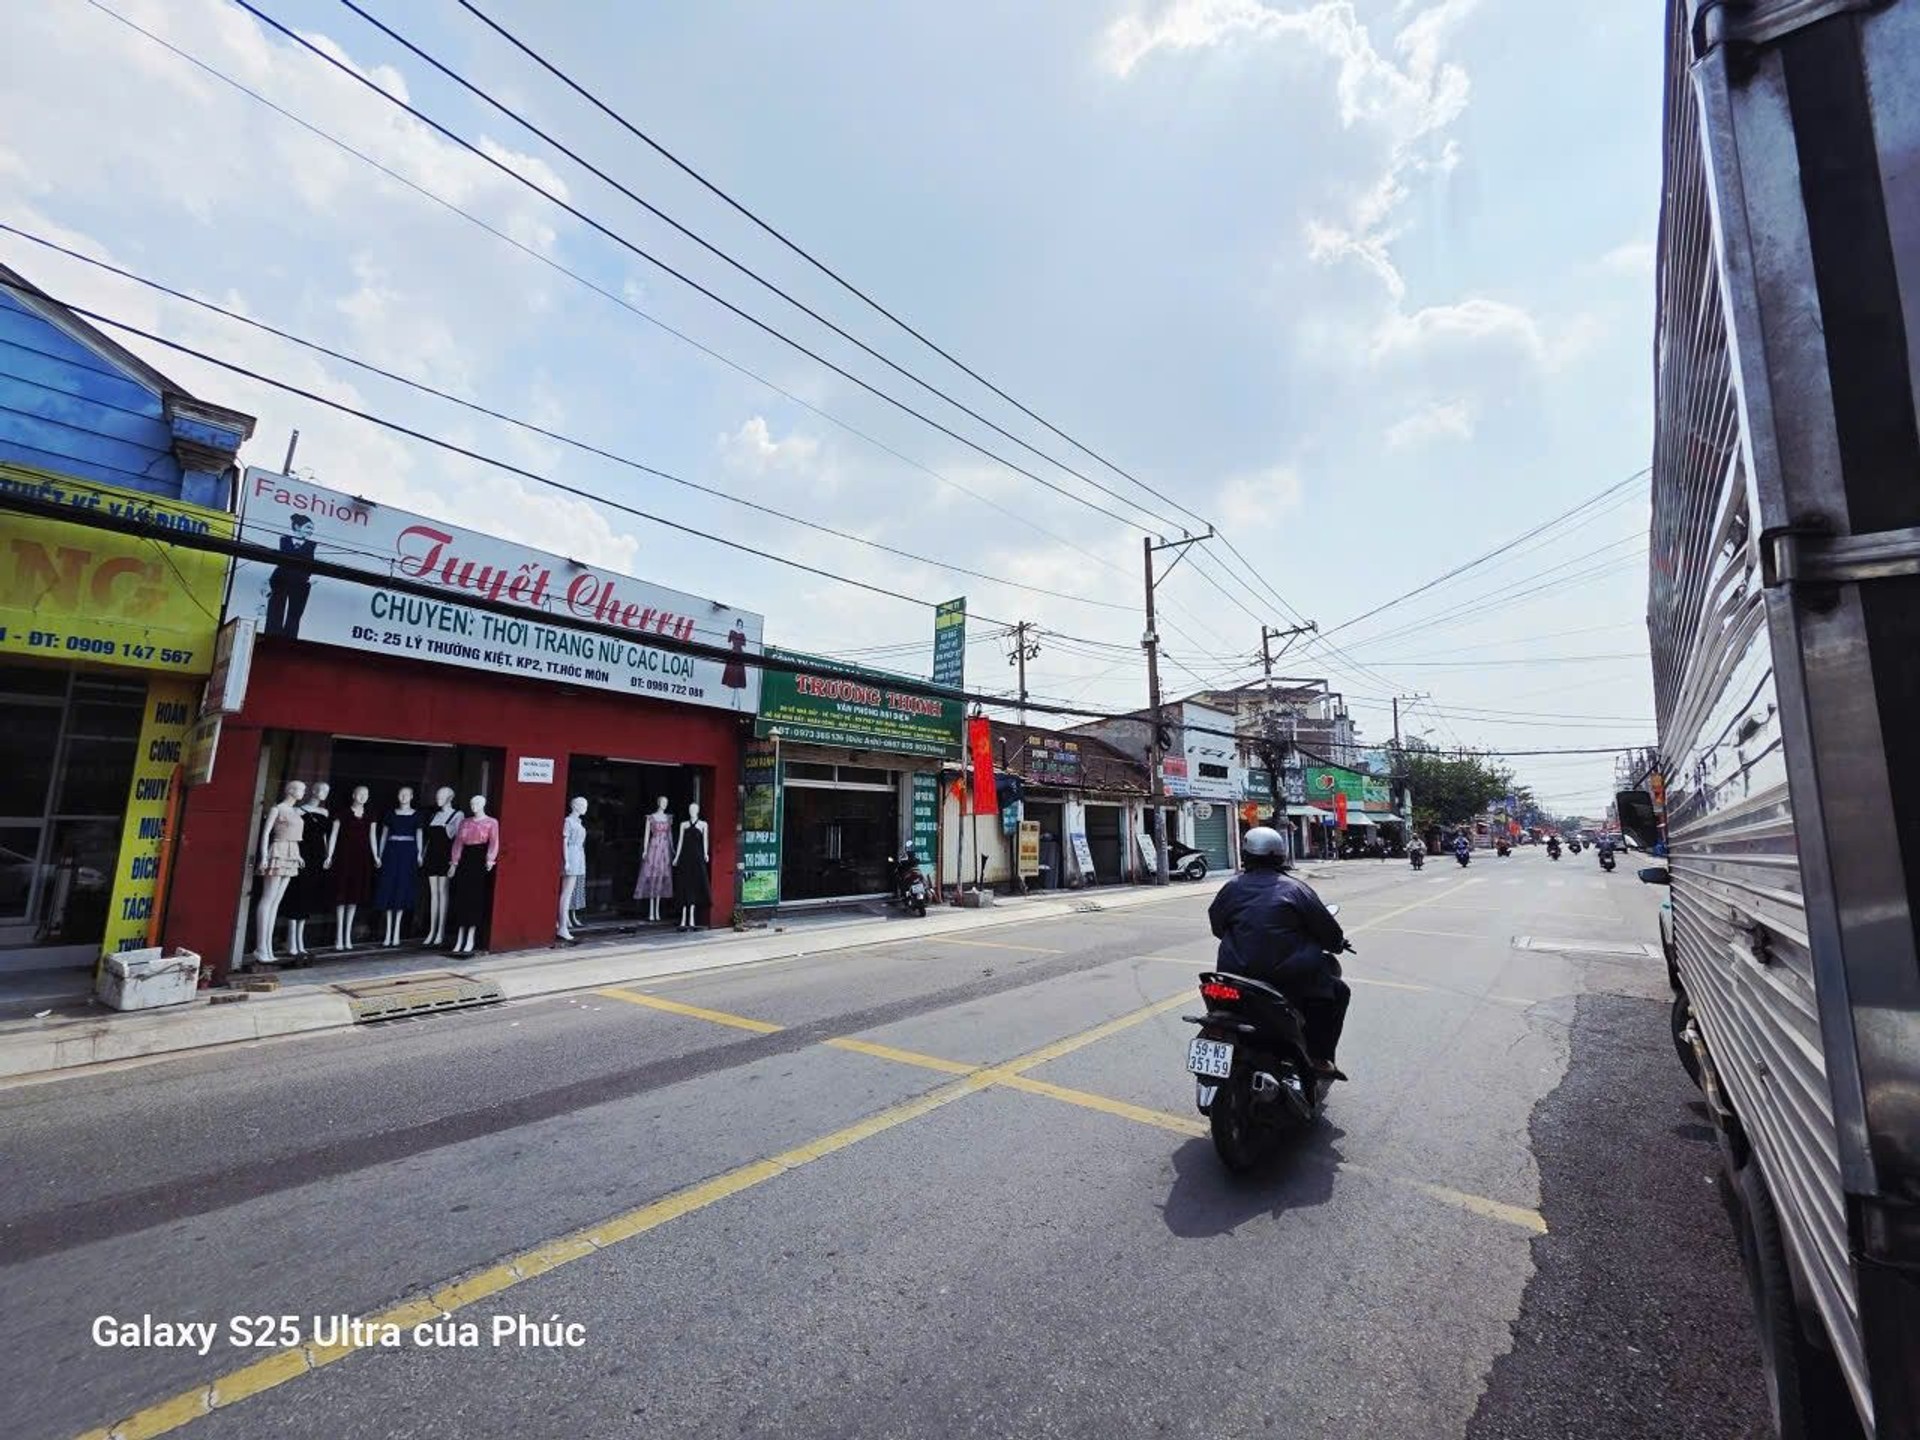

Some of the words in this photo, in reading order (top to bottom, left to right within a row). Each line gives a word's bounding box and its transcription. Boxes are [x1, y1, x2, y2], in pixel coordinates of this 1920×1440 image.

[254, 477, 369, 527] Fashion
[396, 525, 551, 606] Tuyết
[566, 574, 695, 641] Cherry
[29, 631, 60, 648] ĐT:
[66, 636, 115, 655] 0909
[122, 643, 156, 660] 147
[160, 648, 193, 665] 567
[352, 625, 379, 642] ĐC:
[382, 631, 401, 646] 25
[405, 634, 422, 650] LÝ
[427, 640, 481, 661] THƯỜNG
[534, 626, 595, 660] TRANG
[599, 639, 624, 665] NỮ
[662, 653, 695, 682] LOẠI
[671, 684, 687, 696] 722
[836, 702, 852, 713] VĂN
[853, 705, 879, 717] PHÒNG
[149, 736, 181, 763] CÔNG
[1189, 1056, 1229, 1075] 351.59
